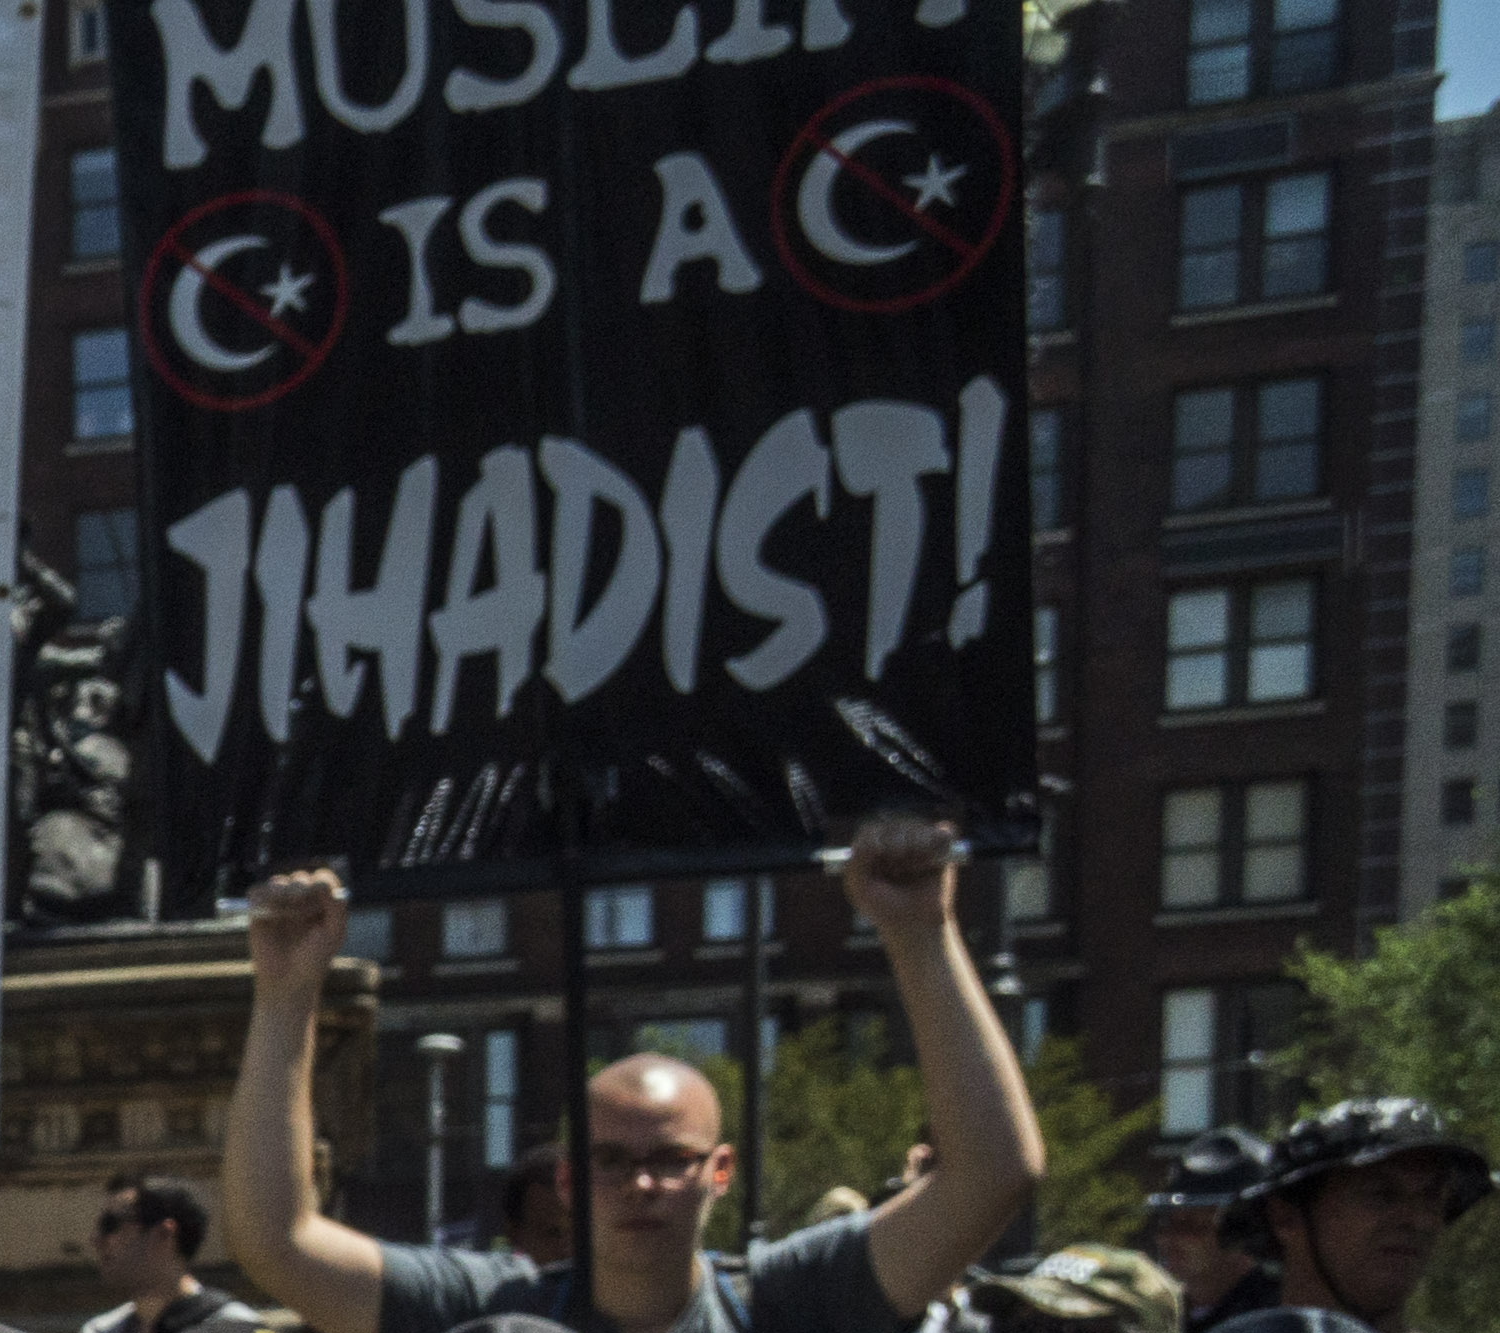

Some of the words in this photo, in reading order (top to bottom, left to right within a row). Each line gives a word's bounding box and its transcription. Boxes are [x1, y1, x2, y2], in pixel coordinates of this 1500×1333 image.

[377, 175, 558, 346] IS
[638, 150, 763, 306] A
[163, 374, 1009, 766] JIHADIST!
